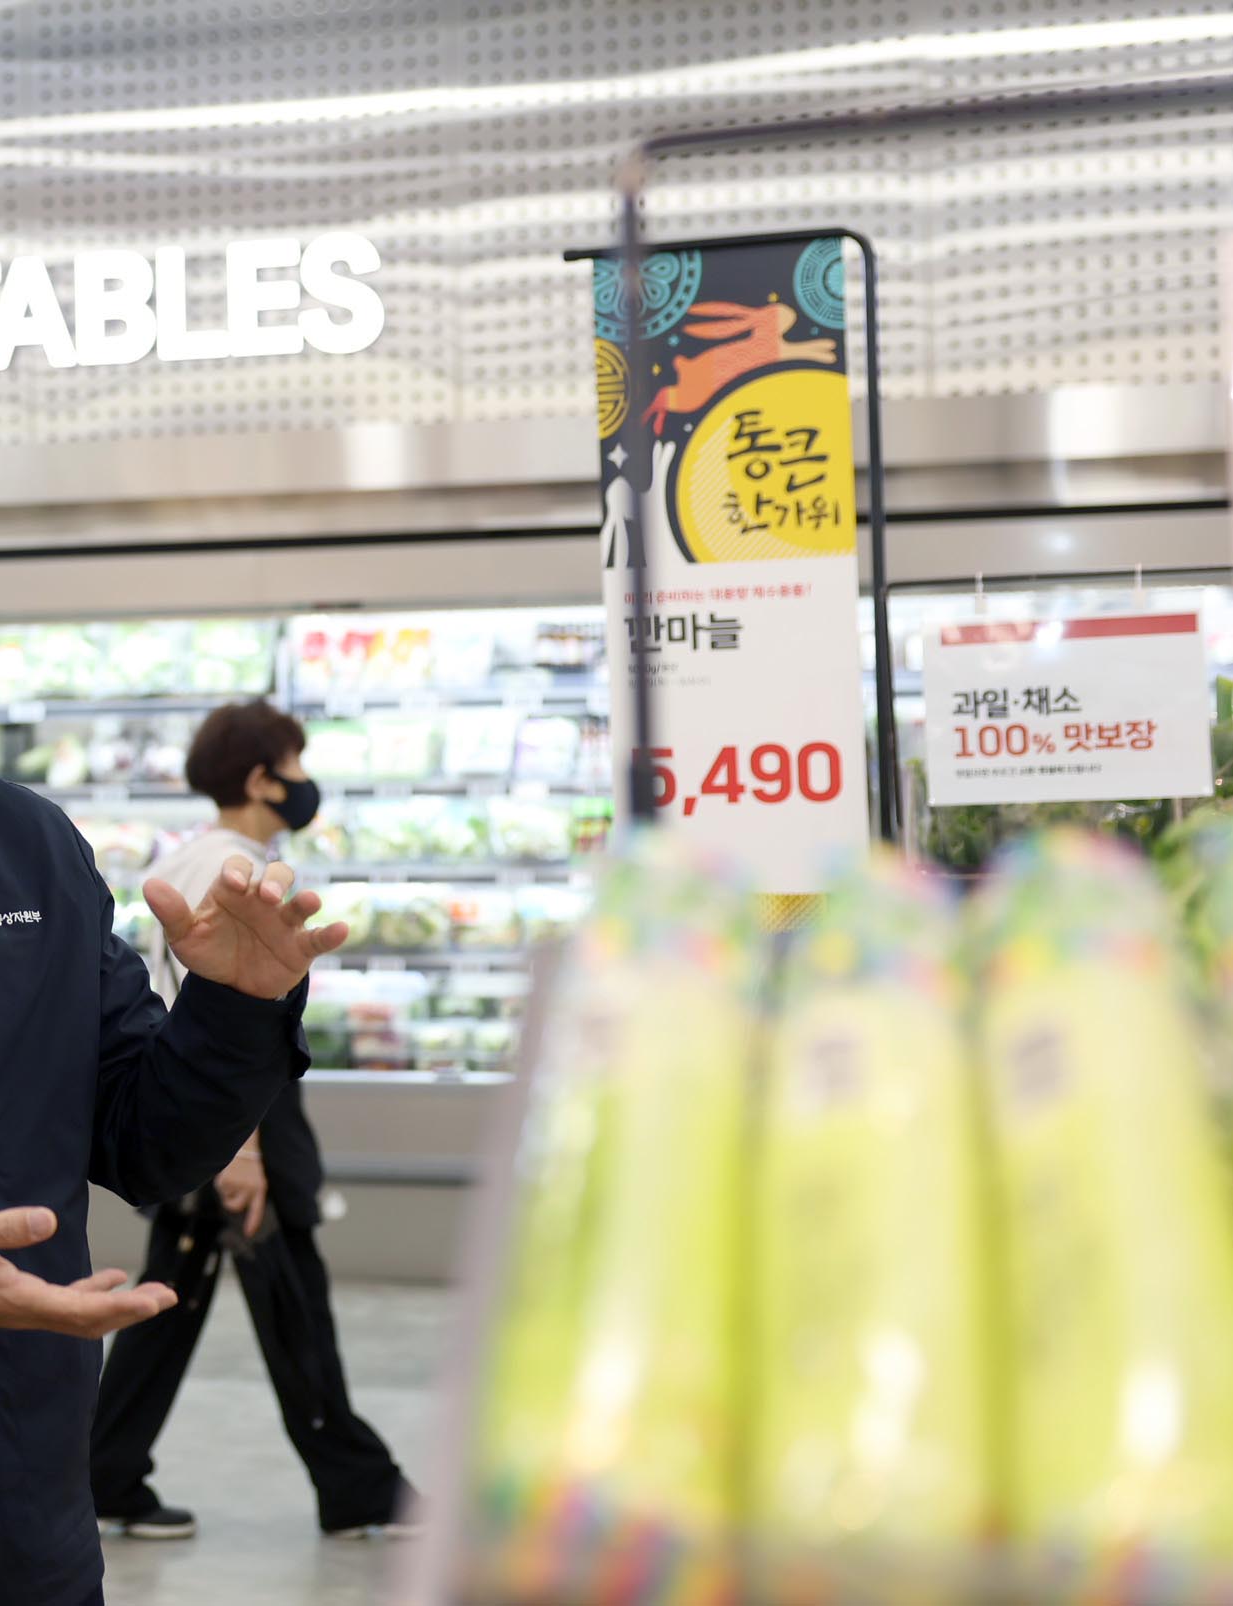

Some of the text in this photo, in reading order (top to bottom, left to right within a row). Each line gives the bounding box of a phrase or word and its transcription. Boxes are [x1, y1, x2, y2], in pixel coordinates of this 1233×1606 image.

[727, 410, 829, 492] 통큰
[722, 491, 841, 535] 한가위
[953, 719, 1157, 760] 100% 맛보장
[631, 741, 842, 816] 5,490
